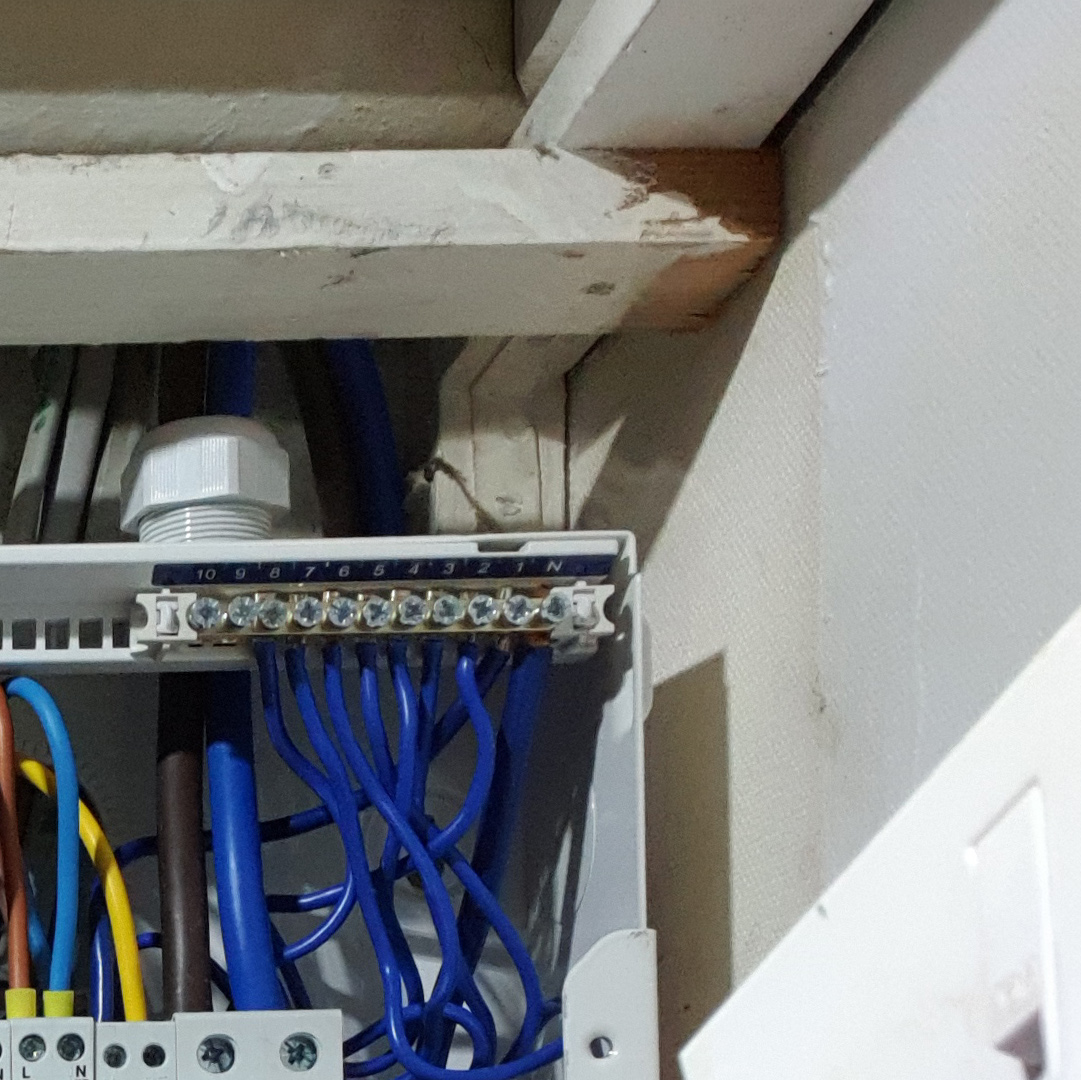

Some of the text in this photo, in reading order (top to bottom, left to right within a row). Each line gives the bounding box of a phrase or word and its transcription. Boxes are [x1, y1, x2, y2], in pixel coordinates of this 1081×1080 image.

[197, 569, 217, 580] 10
[235, 568, 246, 580] 9
[270, 567, 281, 579] 8
[306, 567, 315, 577] 7
[339, 566, 350, 577] 6
[373, 565, 385, 576] 5
[408, 563, 419, 575] 4
[443, 563, 455, 574] 3
[477, 562, 491, 574] 2
[547, 561, 562, 572] N
[22, 1067, 31, 1079] L
[76, 1066, 86, 1078] N
